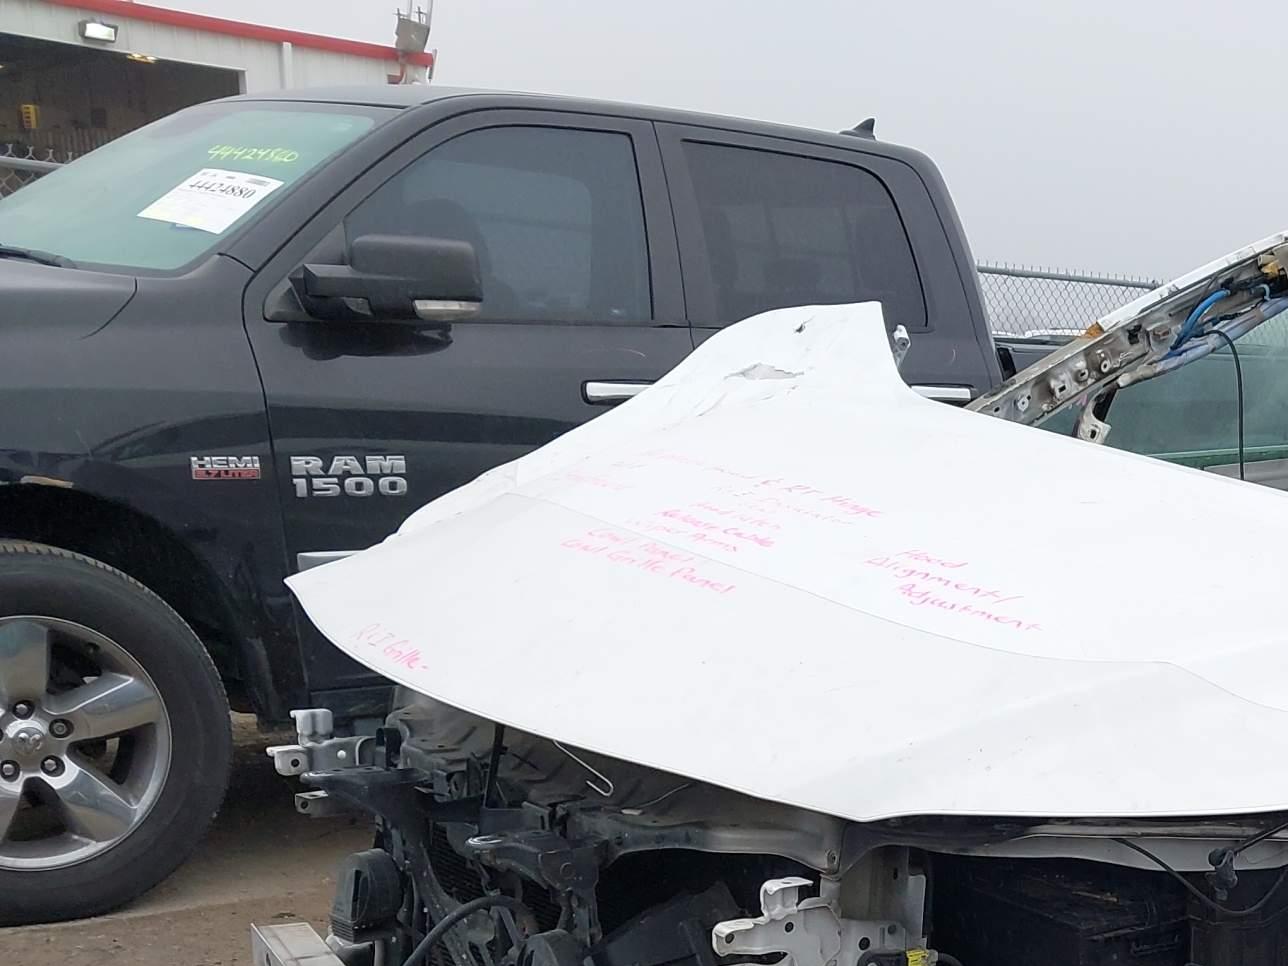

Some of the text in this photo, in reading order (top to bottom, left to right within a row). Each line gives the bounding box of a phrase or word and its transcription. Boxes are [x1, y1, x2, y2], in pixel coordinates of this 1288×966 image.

[190, 180, 256, 199] 44424880
[190, 456, 260, 468] HEMI
[290, 455, 406, 475] RAM
[293, 476, 408, 498] 1500
[671, 567, 736, 593] Panel
